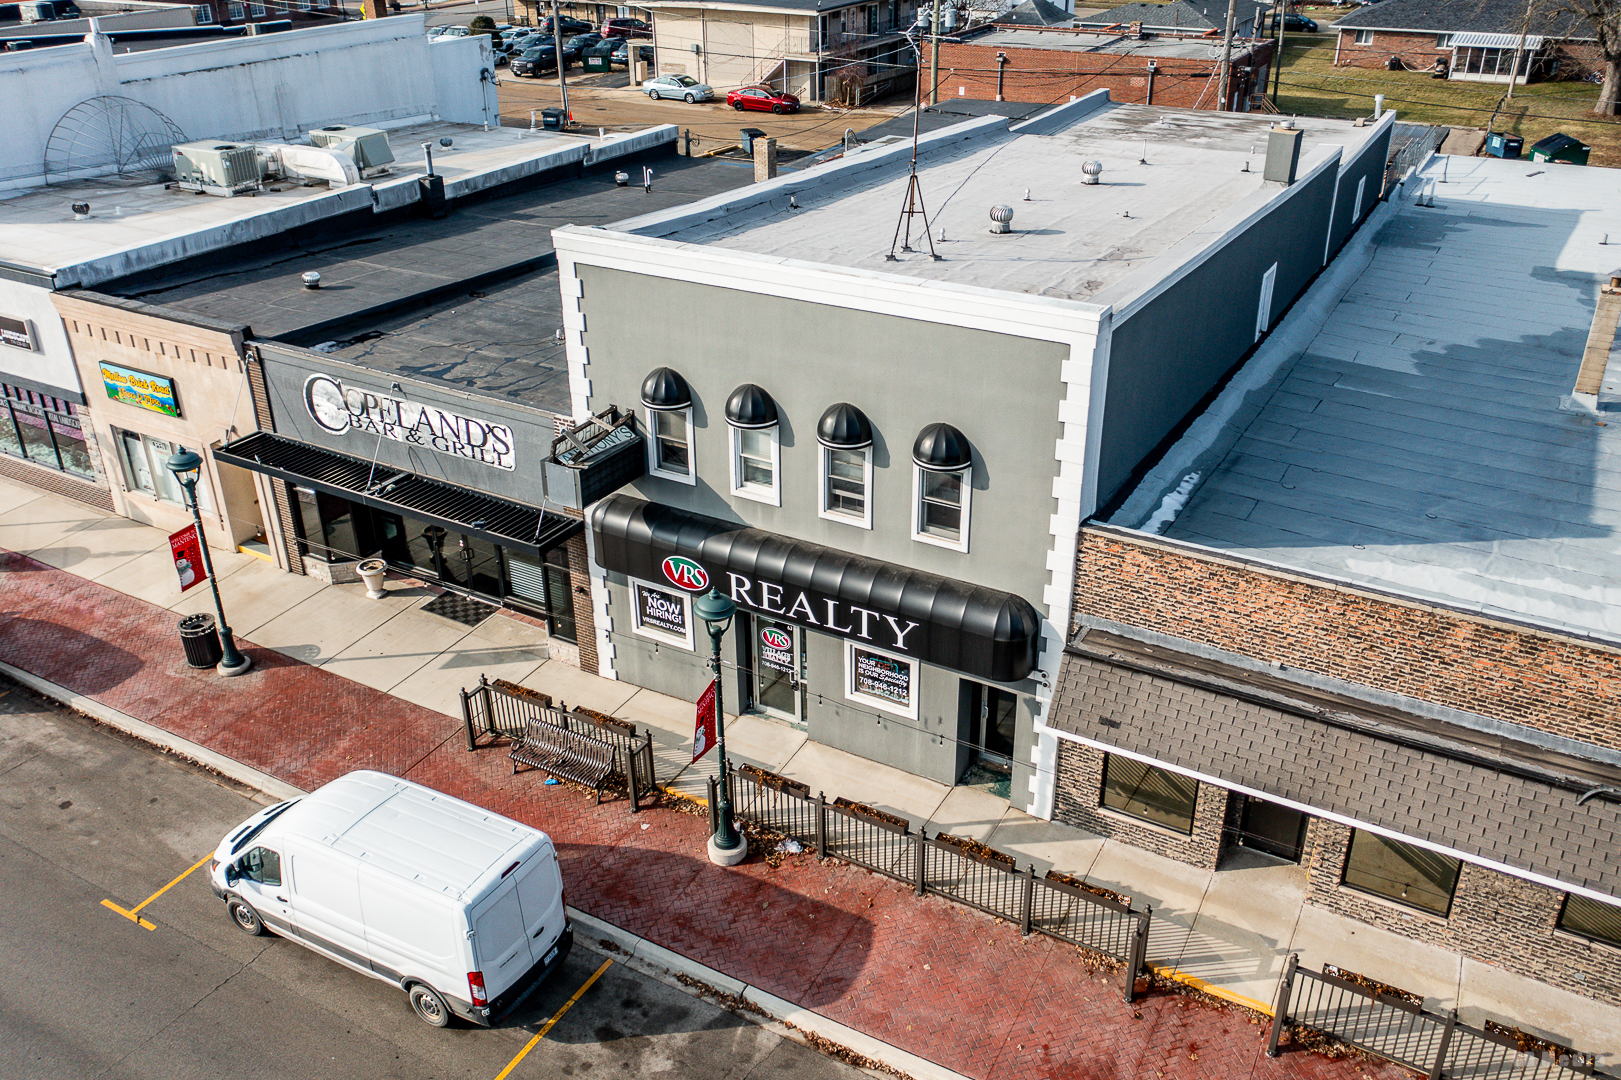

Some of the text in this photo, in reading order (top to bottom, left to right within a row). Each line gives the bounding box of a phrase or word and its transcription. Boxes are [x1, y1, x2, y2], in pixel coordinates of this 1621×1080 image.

[102, 368, 171, 395] Mellow Brick Road
[305, 376, 512, 456] COPELAND'S
[349, 414, 513, 471] BAR & GRILL
[647, 597, 680, 615] NOW
[665, 560, 920, 650] VRS REALTY
[646, 606, 682, 624] HIRING!
[764, 629, 788, 647] VRS
[858, 656, 876, 666] YOUR
[858, 662, 909, 681] NEIGHBORHOOD
[865, 670, 879, 679] OUR
[859, 676, 908, 696] 708-946-1212
